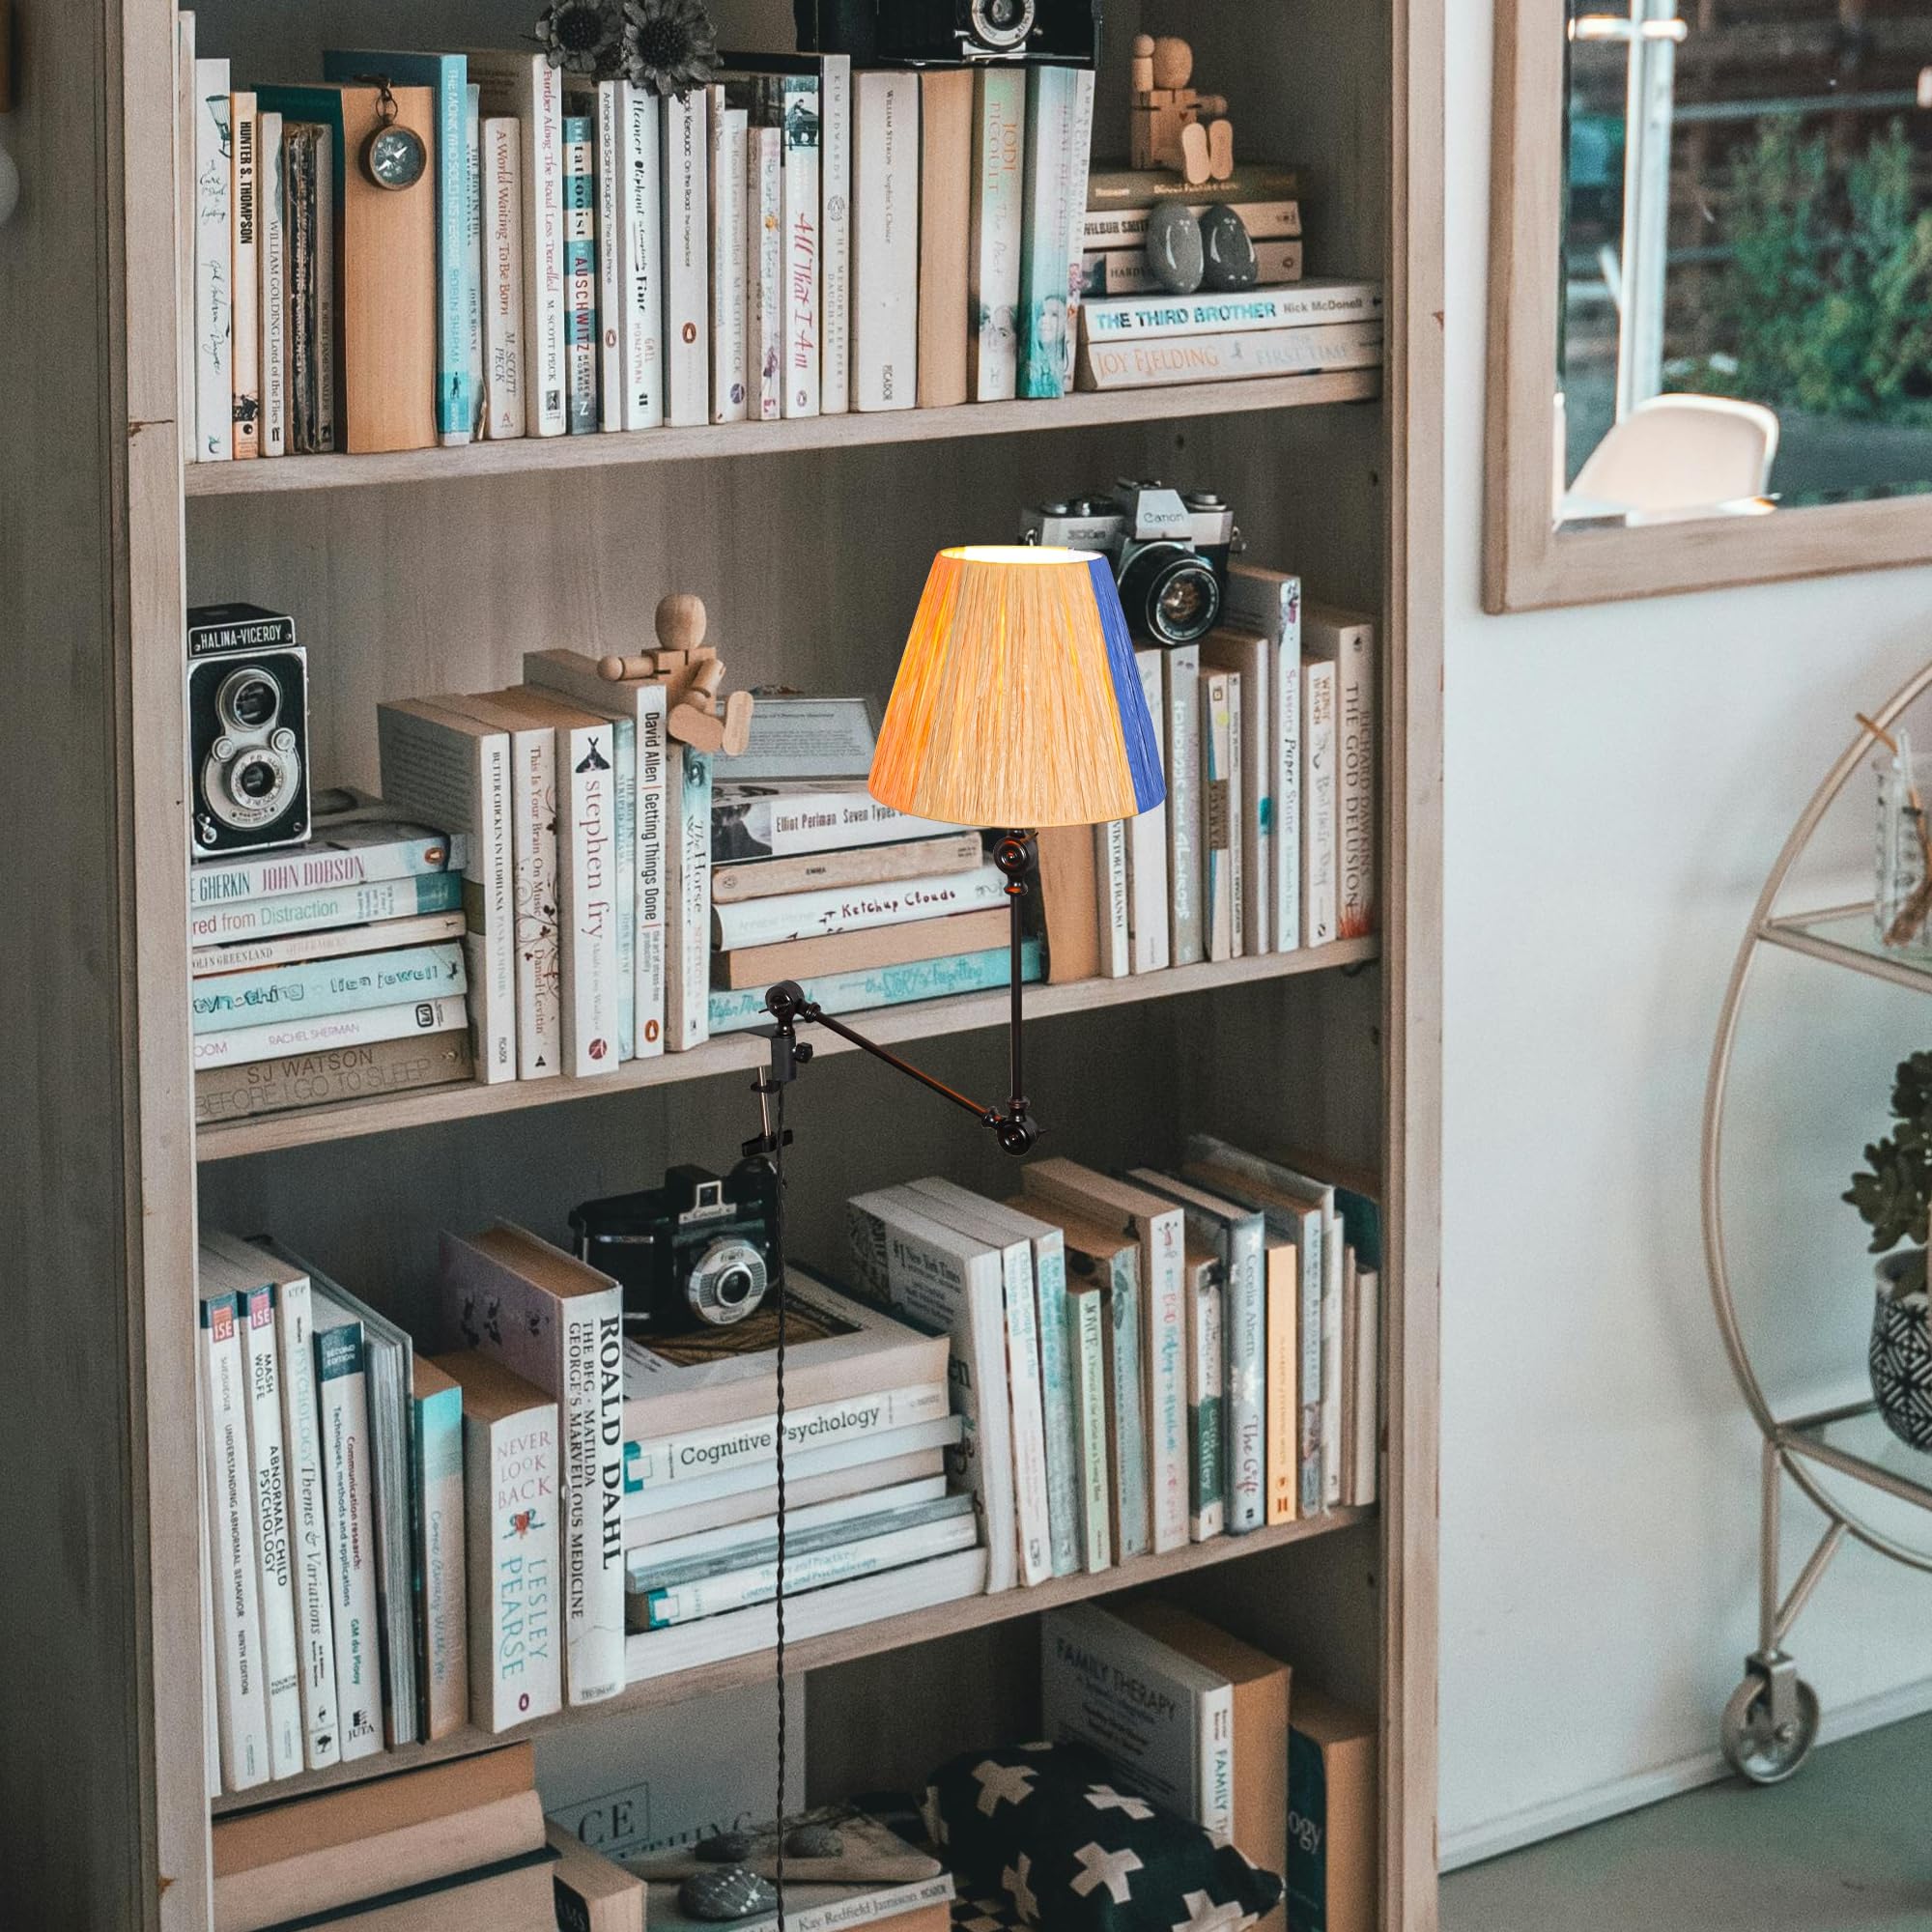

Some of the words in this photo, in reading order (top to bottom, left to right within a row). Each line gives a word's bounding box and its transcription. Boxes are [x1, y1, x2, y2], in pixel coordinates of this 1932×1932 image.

[542, 70, 557, 113] Further
[885, 90, 895, 128] WILLIAM
[603, 93, 612, 131] Antoine
[633, 99, 644, 154] Eleanor
[239, 121, 252, 165] HUNTER
[497, 129, 506, 140] A
[541, 116, 556, 149] Along
[603, 132, 612, 147] de
[682, 115, 694, 156] Kerouac
[987, 101, 1001, 198] PICOULT
[1001, 123, 1018, 172] JODI
[239, 168, 252, 179] S.
[497, 144, 512, 184] World
[543, 153, 555, 174] The
[601, 149, 613, 218] Saint-Exupéry
[683, 159, 693, 173] On
[683, 174, 693, 187] the
[544, 180, 557, 209] Road
[574, 146, 588, 237] tattooist
[632, 160, 645, 216] Oliphant
[683, 188, 693, 212] Road
[239, 182, 252, 244] THOMPSON
[495, 187, 511, 240] Waiting
[545, 213, 557, 238] Less
[1083, 220, 1119, 236] WILBUR
[270, 220, 279, 274] WILLIAM
[498, 242, 510, 261] To
[793, 212, 815, 256] All
[498, 263, 510, 277] Be
[545, 242, 559, 292] Travelled
[605, 258, 613, 284] Prince
[792, 258, 813, 307] That
[270, 277, 279, 335] GOLDING
[499, 284, 511, 316] Born
[575, 257, 589, 352] AUSCHWITZ
[635, 275, 648, 316] Fine
[836, 265, 844, 319] MEMORY
[1283, 302, 1307, 314] Nick
[547, 314, 556, 350] SCOTT
[793, 309, 813, 329] I
[1096, 312, 1132, 329] THE
[1135, 307, 1190, 328] THIRD
[1193, 301, 1277, 324] BROTHER
[270, 338, 279, 364] Lord
[495, 347, 505, 383] PECK
[547, 353, 556, 381] PECK
[792, 329, 814, 369] Am
[1096, 351, 1129, 379] JOY
[1133, 347, 1219, 374] FIELDING
[270, 366, 279, 378] of
[270, 380, 279, 397] the
[505, 352, 517, 396] SCOTT
[881, 364, 893, 401] PICADOR
[270, 399, 279, 424] Flies
[1143, 512, 1184, 523] Canon
[200, 625, 283, 649] HALINA-VICEROY
[1346, 681, 1359, 727] THE
[644, 711, 661, 748] David
[530, 747, 542, 772] This
[644, 751, 661, 782] Allen
[1283, 738, 1297, 784] Paper
[1346, 734, 1359, 787] GOD
[1359, 710, 1372, 790] RICHARD
[493, 752, 502, 791] BUTTER
[530, 776, 542, 786] Is
[493, 794, 502, 839] CHICKEN
[531, 789, 542, 819] Your
[640, 793, 661, 840] Getting
[776, 816, 800, 834] Elliot
[802, 811, 838, 831] Perlman
[842, 808, 869, 824] Seven
[494, 843, 503, 855] IN
[531, 823, 542, 855] Brain
[580, 780, 608, 891] stephen
[1112, 821, 1122, 869] VIKTOR
[1345, 796, 1360, 908] DELUSION
[1360, 796, 1372, 876] DAWKINS
[199, 870, 251, 902] GHERKIN
[261, 865, 299, 892] JOHN
[303, 854, 365, 887] DOBSON
[494, 857, 504, 911] LUDHIANA
[532, 858, 543, 878] On
[640, 842, 661, 886] Things
[693, 850, 707, 913] Horse
[222, 912, 256, 931] from
[261, 899, 339, 925] Distraction
[532, 881, 544, 917] Music
[643, 888, 660, 921] Done
[841, 898, 899, 919] Ketchup
[904, 889, 957, 907] Clouds
[581, 900, 610, 940] fry
[216, 947, 274, 966] GREENLAND
[534, 949, 546, 989] Daniel
[534, 992, 546, 1035] Levitin
[246, 1066, 274, 1084] SJ
[281, 1047, 374, 1078] WATSON
[195, 1084, 276, 1118] BEFORE
[294, 1076, 329, 1100] GO
[336, 1070, 362, 1093] TO
[366, 1057, 433, 1088] SLEEP
[1244, 1254, 1259, 1308] Cecelia
[213, 1320, 234, 1340] ISE
[252, 1308, 270, 1327] ISE
[582, 1319, 595, 1354] THE
[1245, 1312, 1259, 1357] Ahern
[253, 1352, 265, 1402] WOLFE
[263, 1353, 274, 1394] MASH
[568, 1321, 582, 1407] GEORGE'S
[582, 1359, 595, 1392] BFG
[599, 1313, 621, 1446] ROALD
[295, 1347, 313, 1461] PSYCHOLOGY
[330, 1406, 343, 1469] Techniques,
[497, 1430, 553, 1461] NEVER
[582, 1409, 596, 1488] MATILDA
[680, 1431, 772, 1466] Cognitive
[1242, 1414, 1260, 1455] The
[225, 1424, 238, 1508] UNDERSTANDING
[346, 1435, 360, 1521] Communication
[500, 1455, 547, 1485] LOOK
[569, 1411, 583, 1528] MARVELLOUS
[1236, 1458, 1260, 1496] Gift
[270, 1445, 285, 1537] ABNORMAL
[301, 1461, 317, 1527] Themes
[334, 1471, 347, 1519] methods
[497, 1474, 553, 1510] BACK
[258, 1469, 275, 1574] PSYCHOLOGY
[338, 1520, 349, 1541] and
[601, 1459, 623, 1571] DAHL
[230, 1510, 242, 1566] ABNORMAL
[304, 1530, 321, 1547] &
[350, 1522, 363, 1571] research:
[274, 1538, 288, 1587] CHILD
[339, 1543, 353, 1607] applications
[570, 1532, 584, 1619] MEDICINE
[234, 1569, 245, 1618] BEHAVIOR
[305, 1551, 323, 1635] Variations
[527, 1558, 548, 1660] LESLEY
[350, 1618, 361, 1637] GM
[497, 1555, 525, 1681] PEARSE
[238, 1630, 247, 1658] NINTH
[351, 1638, 361, 1654] du
[240, 1660, 250, 1696] EDITION
[350, 1655, 363, 1685] Plooy
[1055, 1636, 1109, 1682] FAMILY
[1113, 1666, 1176, 1721] THERAPY
[348, 1722, 375, 1741] JUTA
[1214, 1747, 1229, 1810] FAMILY
[825, 1902, 869, 1924] Redfield
[872, 1893, 919, 1914] Jamison
